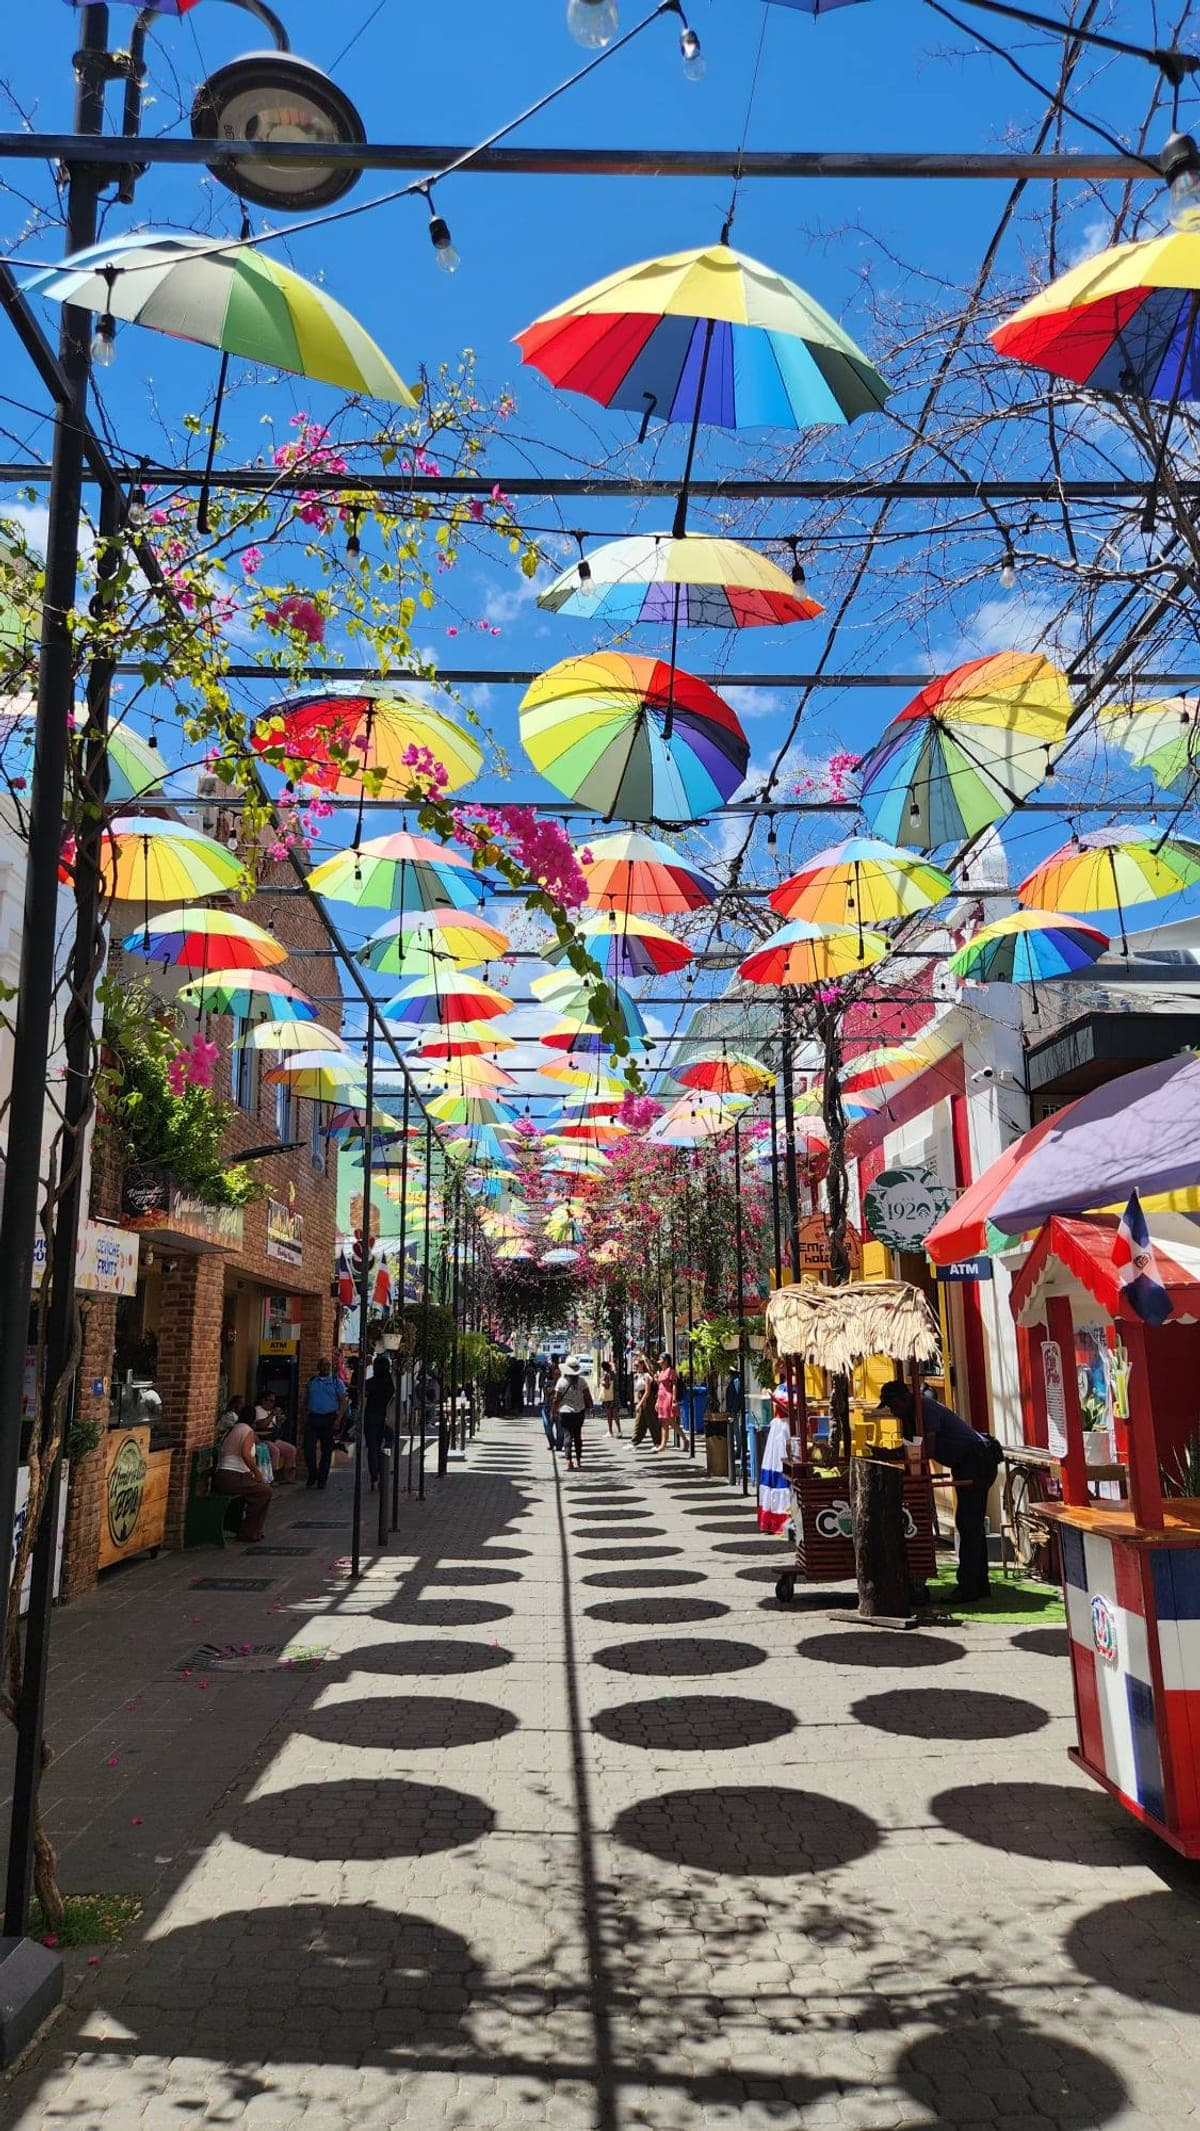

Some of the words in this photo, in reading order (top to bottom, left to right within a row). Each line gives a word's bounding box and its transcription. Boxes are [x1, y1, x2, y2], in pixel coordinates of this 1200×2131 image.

[97, 1259, 117, 1276] FRUITS
[950, 1263, 979, 1275] ATM
[271, 1341, 287, 1349] ATM
